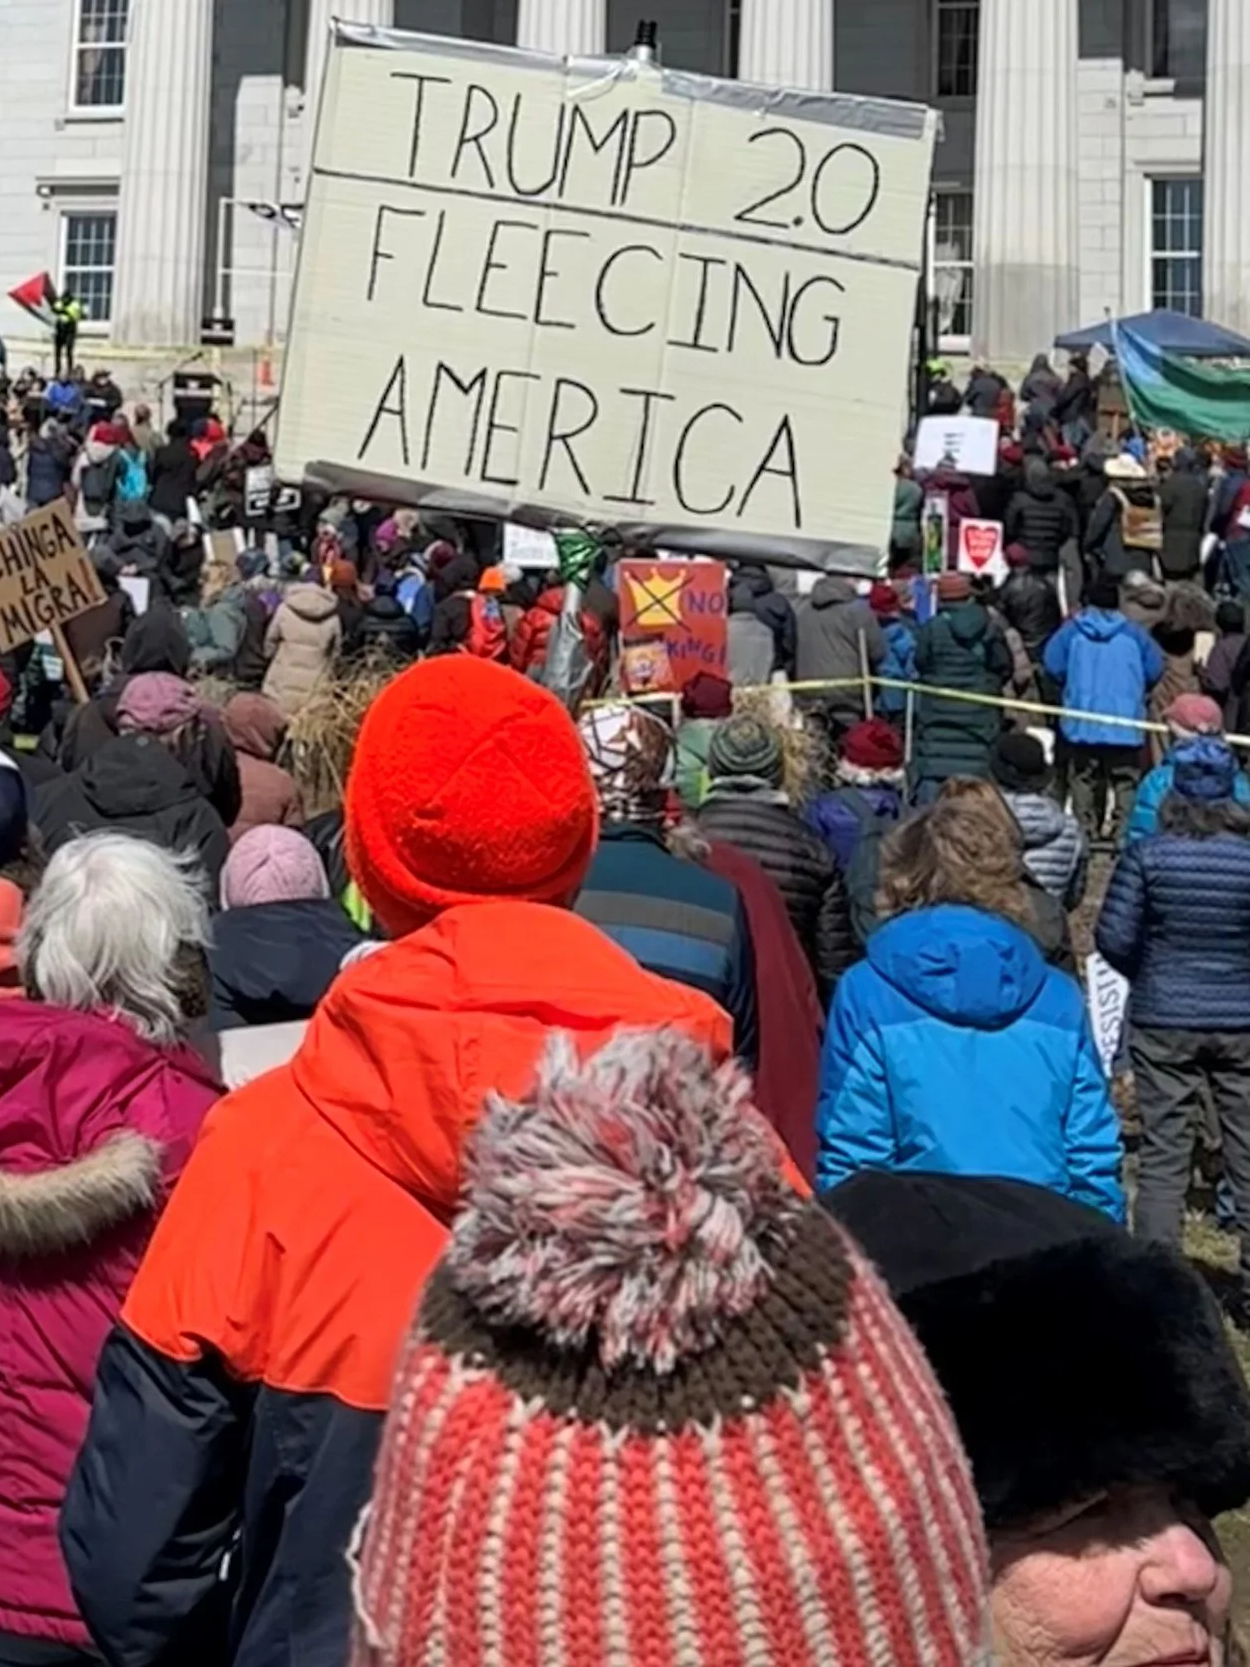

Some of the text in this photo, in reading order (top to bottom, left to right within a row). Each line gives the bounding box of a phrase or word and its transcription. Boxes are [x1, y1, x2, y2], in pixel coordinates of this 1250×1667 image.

[390, 72, 880, 234] TRUMP 2.0
[368, 204, 846, 367] FLEECING
[357, 353, 803, 529] AMERICA
[21, 565, 50, 595] LA
[687, 590, 724, 614] NO
